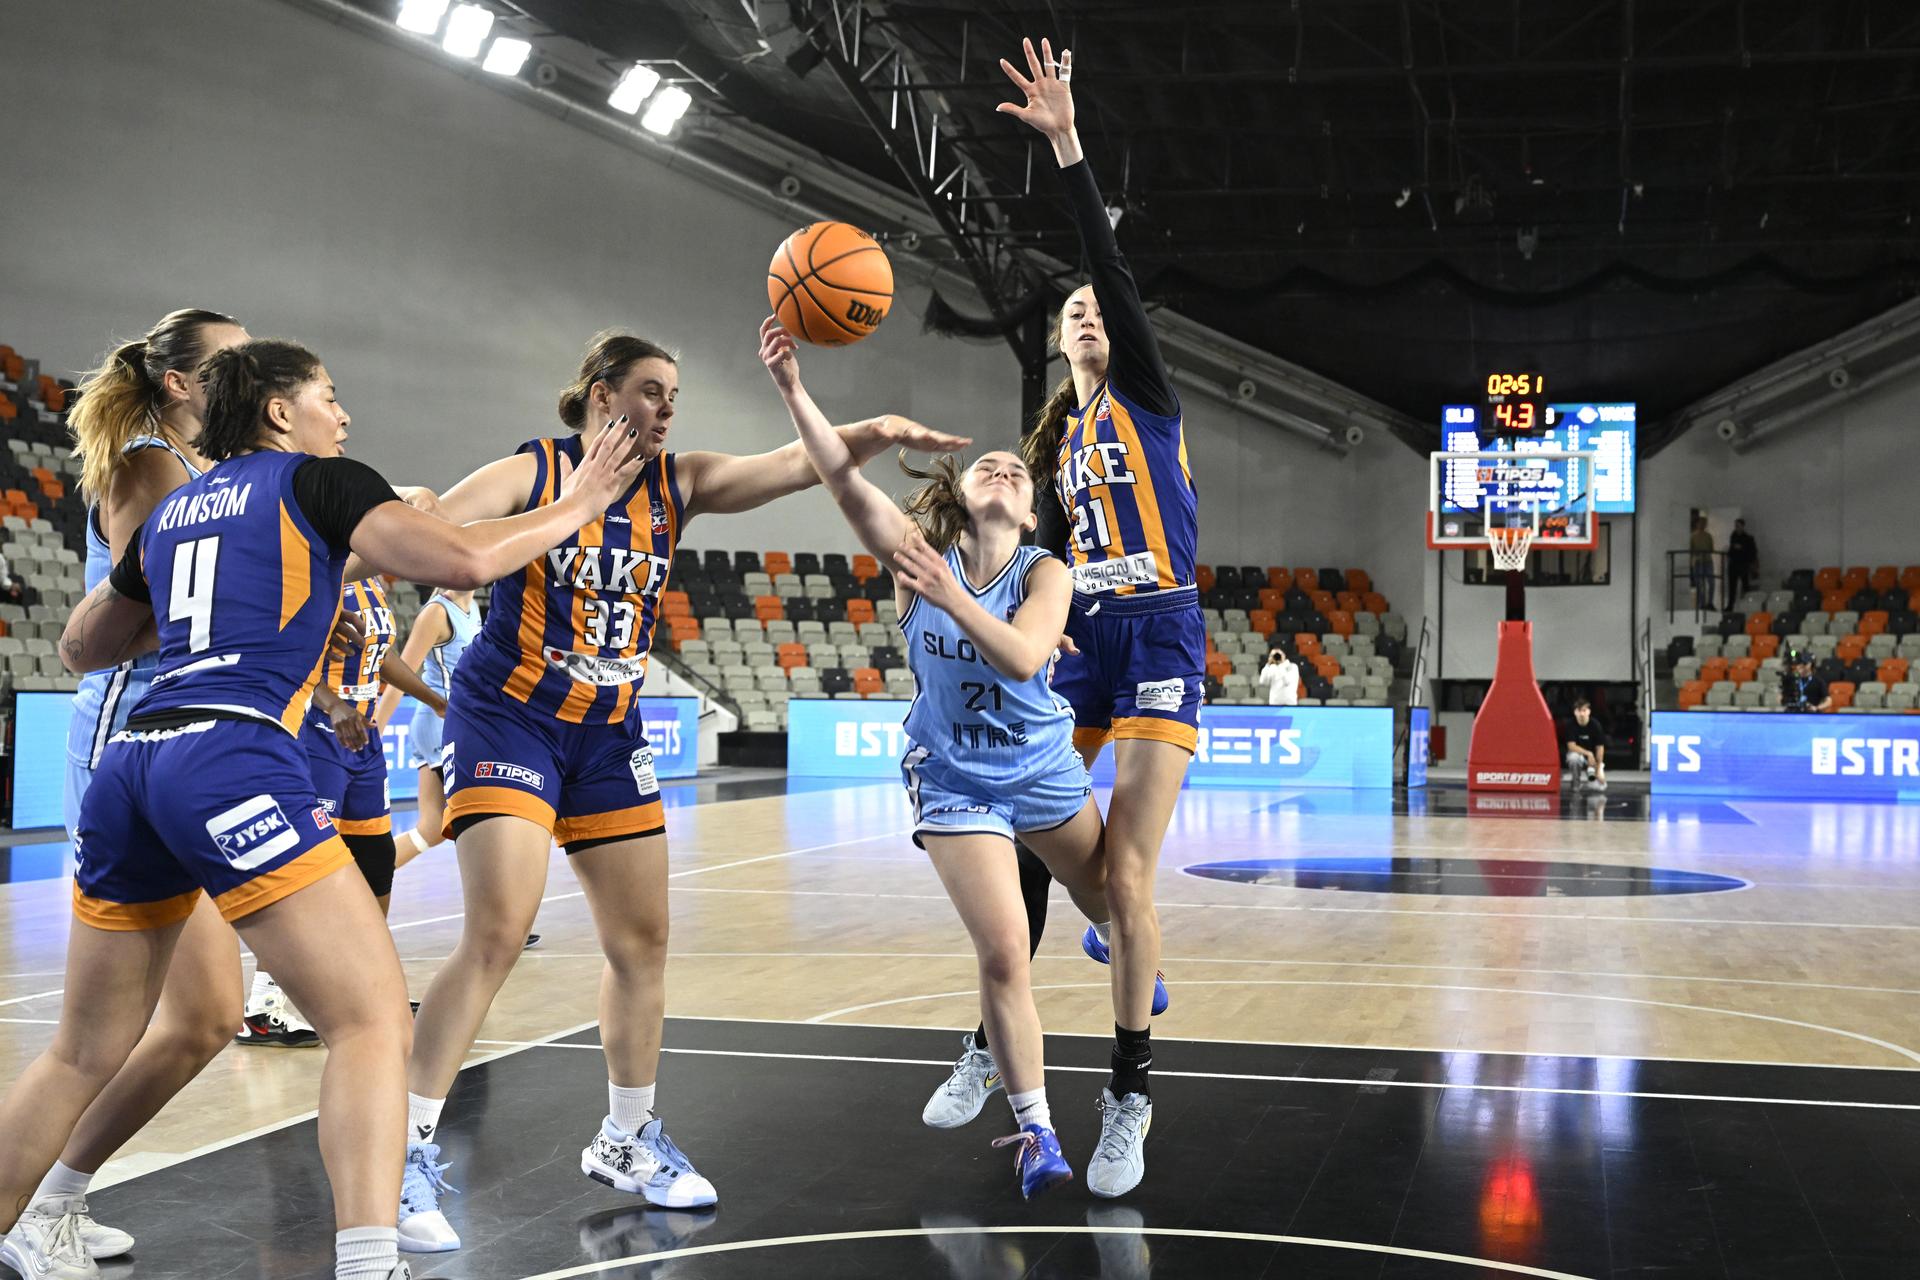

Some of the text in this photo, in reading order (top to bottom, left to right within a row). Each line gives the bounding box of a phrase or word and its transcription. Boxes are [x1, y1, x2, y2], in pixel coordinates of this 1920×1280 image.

[1496, 403, 1534, 428] 4.3
[1495, 468, 1542, 481] TIPOS
[156, 483, 253, 534] RANSOM
[1073, 497, 1112, 553] 21
[547, 546, 669, 599] YAKE
[1079, 556, 1149, 580] VISION IT
[167, 535, 220, 655] 4
[583, 600, 635, 649] 33
[923, 630, 989, 665] SLO
[961, 681, 1002, 712] 21
[1651, 735, 1702, 772] TS
[495, 764, 542, 787] TIPOS
[235, 812, 284, 848] JYSK
